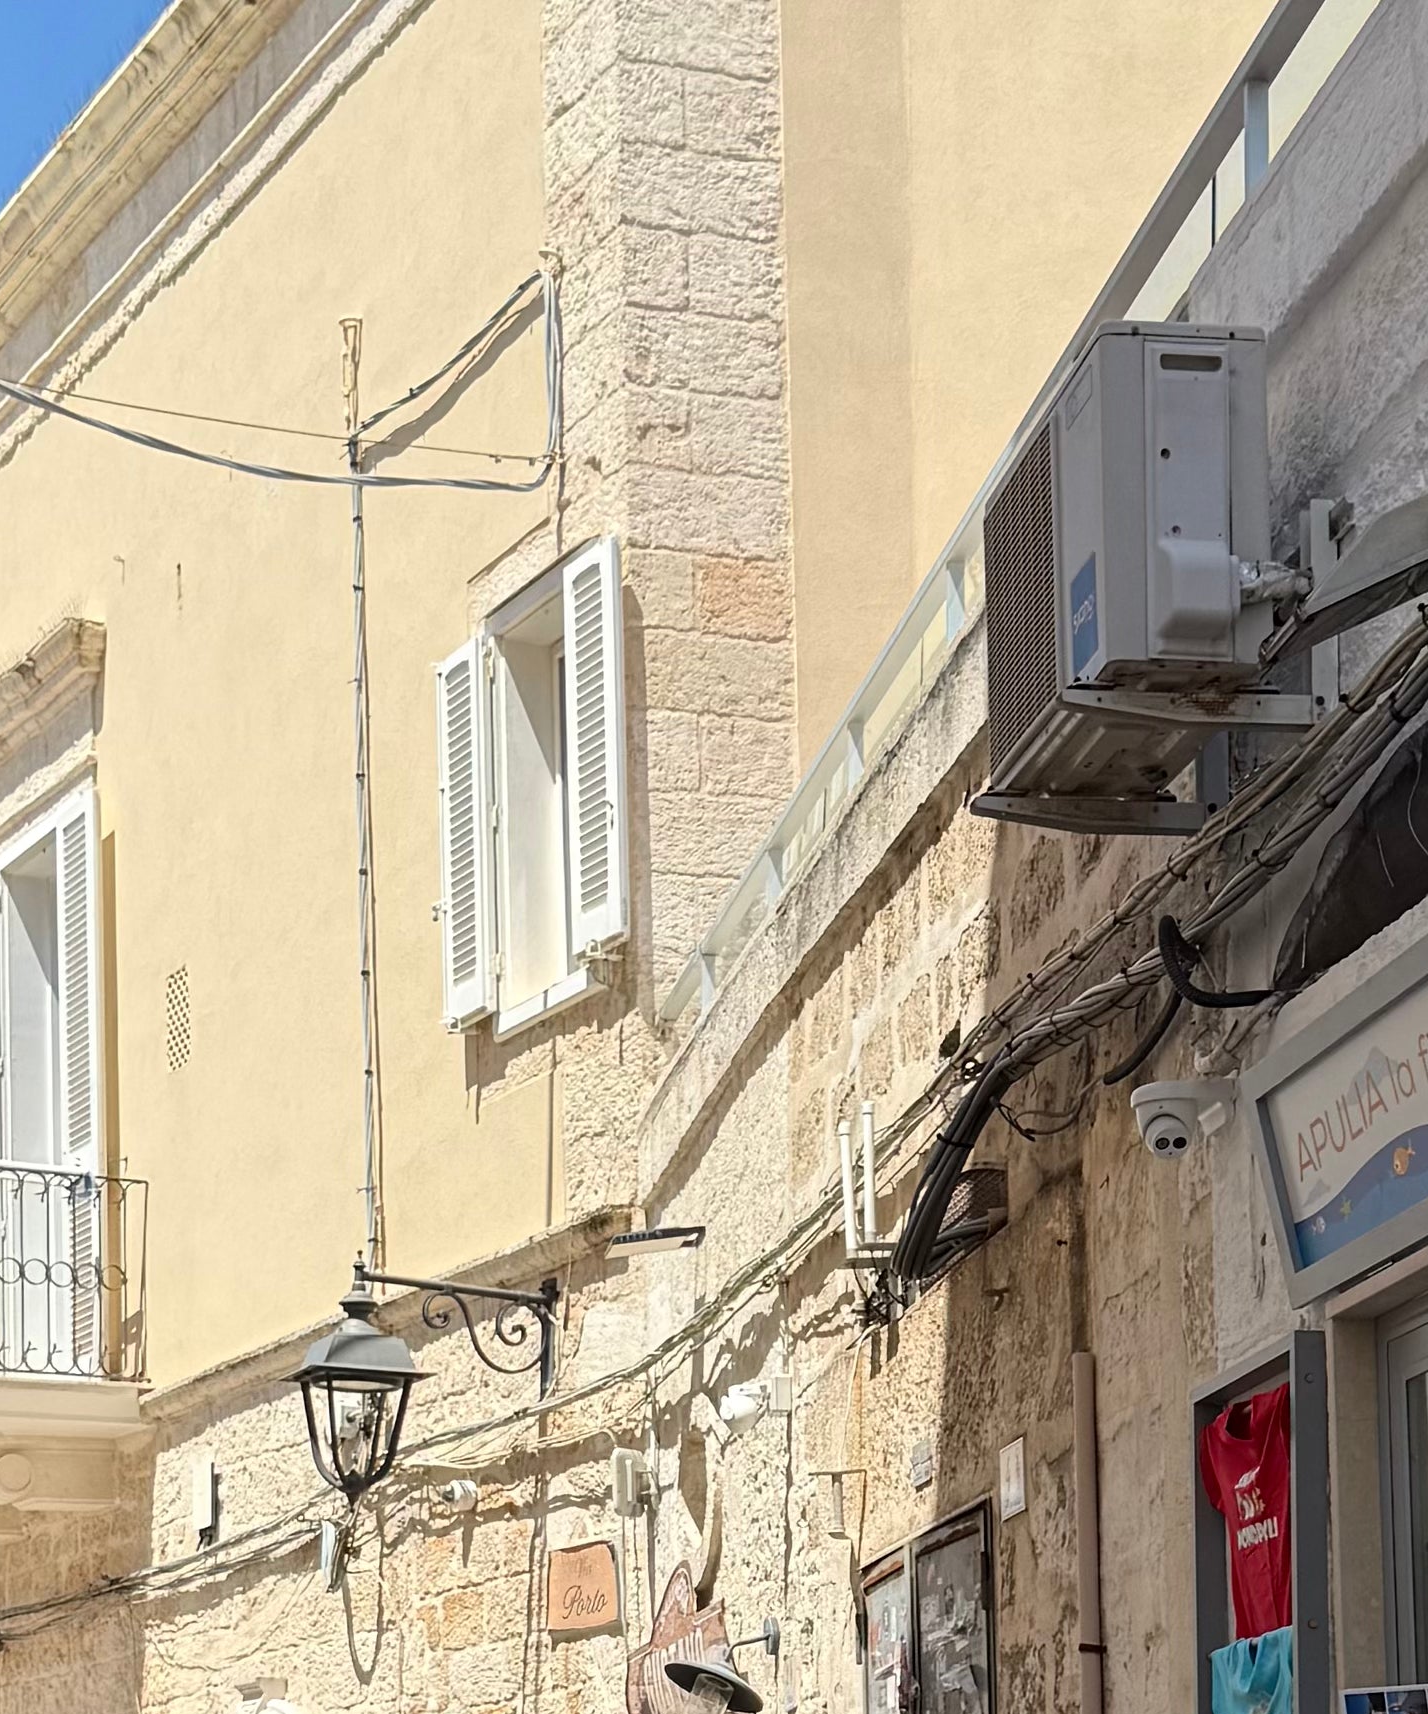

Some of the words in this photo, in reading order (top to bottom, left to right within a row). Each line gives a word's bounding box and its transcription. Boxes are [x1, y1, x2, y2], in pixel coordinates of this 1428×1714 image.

[1297, 1071, 1389, 1183] APULIA
[1387, 1052, 1415, 1106] la
[561, 1584, 609, 1621] Porto
